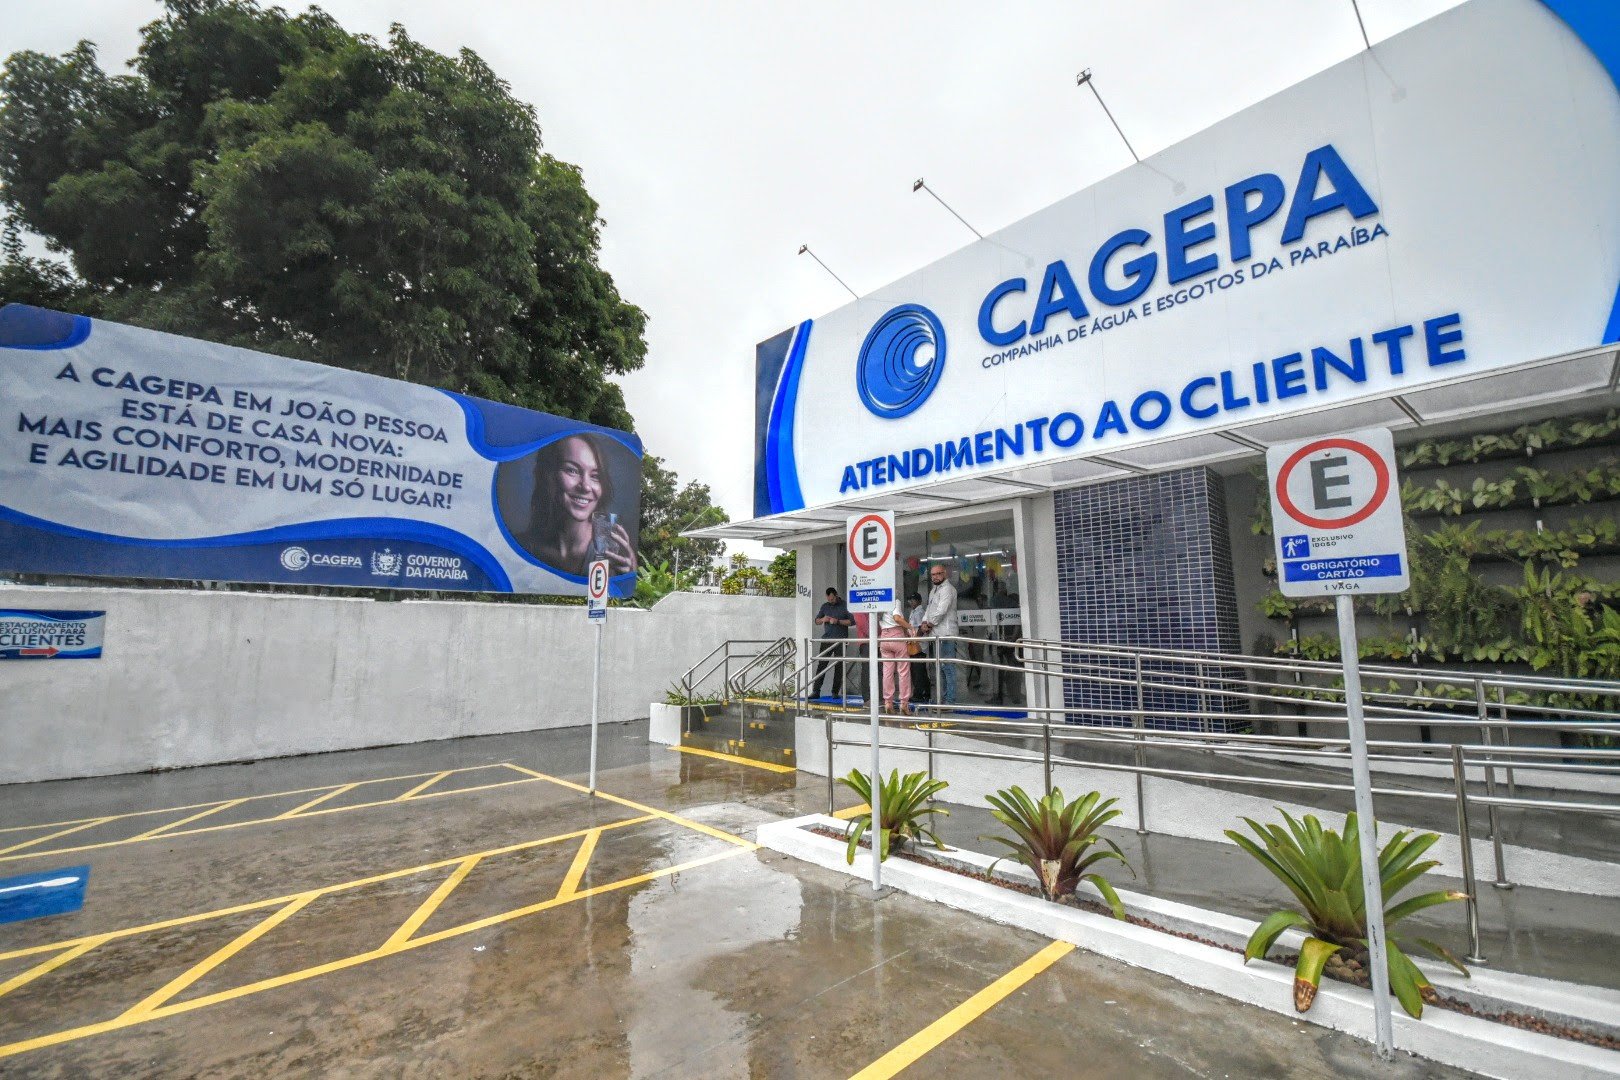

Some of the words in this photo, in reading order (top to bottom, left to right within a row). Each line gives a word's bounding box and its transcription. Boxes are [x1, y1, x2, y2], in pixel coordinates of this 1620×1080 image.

[977, 143, 1380, 347] CAGEPA
[981, 334, 1064, 369] COMPANHIA
[1067, 325, 1088, 342] DE
[1090, 309, 1138, 335] ÁGUA
[1142, 302, 1152, 316] E
[1156, 269, 1245, 312] ESGOTOS
[1250, 257, 1284, 279] DA
[1290, 223, 1389, 267] PARAÍBA
[56, 362, 80, 383] A
[92, 367, 223, 405] CAGEPA
[233, 390, 273, 414] EM
[280, 399, 356, 426] JOÃO
[364, 412, 448, 444] PESSOA
[838, 411, 1085, 493] ATENDIMENTO
[1092, 390, 1172, 439] AO
[1179, 312, 1466, 419] CLIENTE
[121, 398, 197, 428] ESTÁ
[207, 412, 243, 434] DE
[251, 420, 322, 445] CASA
[331, 431, 403, 458] NOVA:
[18, 412, 103, 442] MAIS
[112, 425, 286, 468] CONFORTO,
[295, 449, 463, 489] MODERNIDADE
[29, 443, 49, 464] E
[58, 447, 227, 484] AGILIDADE
[236, 467, 275, 489] EM
[282, 473, 322, 494] UM
[330, 478, 364, 499] SÓ
[372, 484, 453, 510] LUGAR!
[1310, 456, 1352, 510] E
[863, 526, 877, 559] E
[1311, 534, 1354, 542] EXCLUSIVO
[312, 554, 362, 567] CAGEPA
[406, 554, 461, 569] GOVERNO
[1301, 558, 1380, 571] OBRIGATÓRIO
[406, 566, 421, 578] DA
[423, 567, 468, 580] PARAÍBA
[595, 570, 601, 590] E
[1318, 569, 1364, 579] CARTÃO
[1331, 583, 1360, 591] VAGA
[0, 621, 86, 629] ESTACIONAMENTO
[0, 634, 85, 646] CLIENTES
